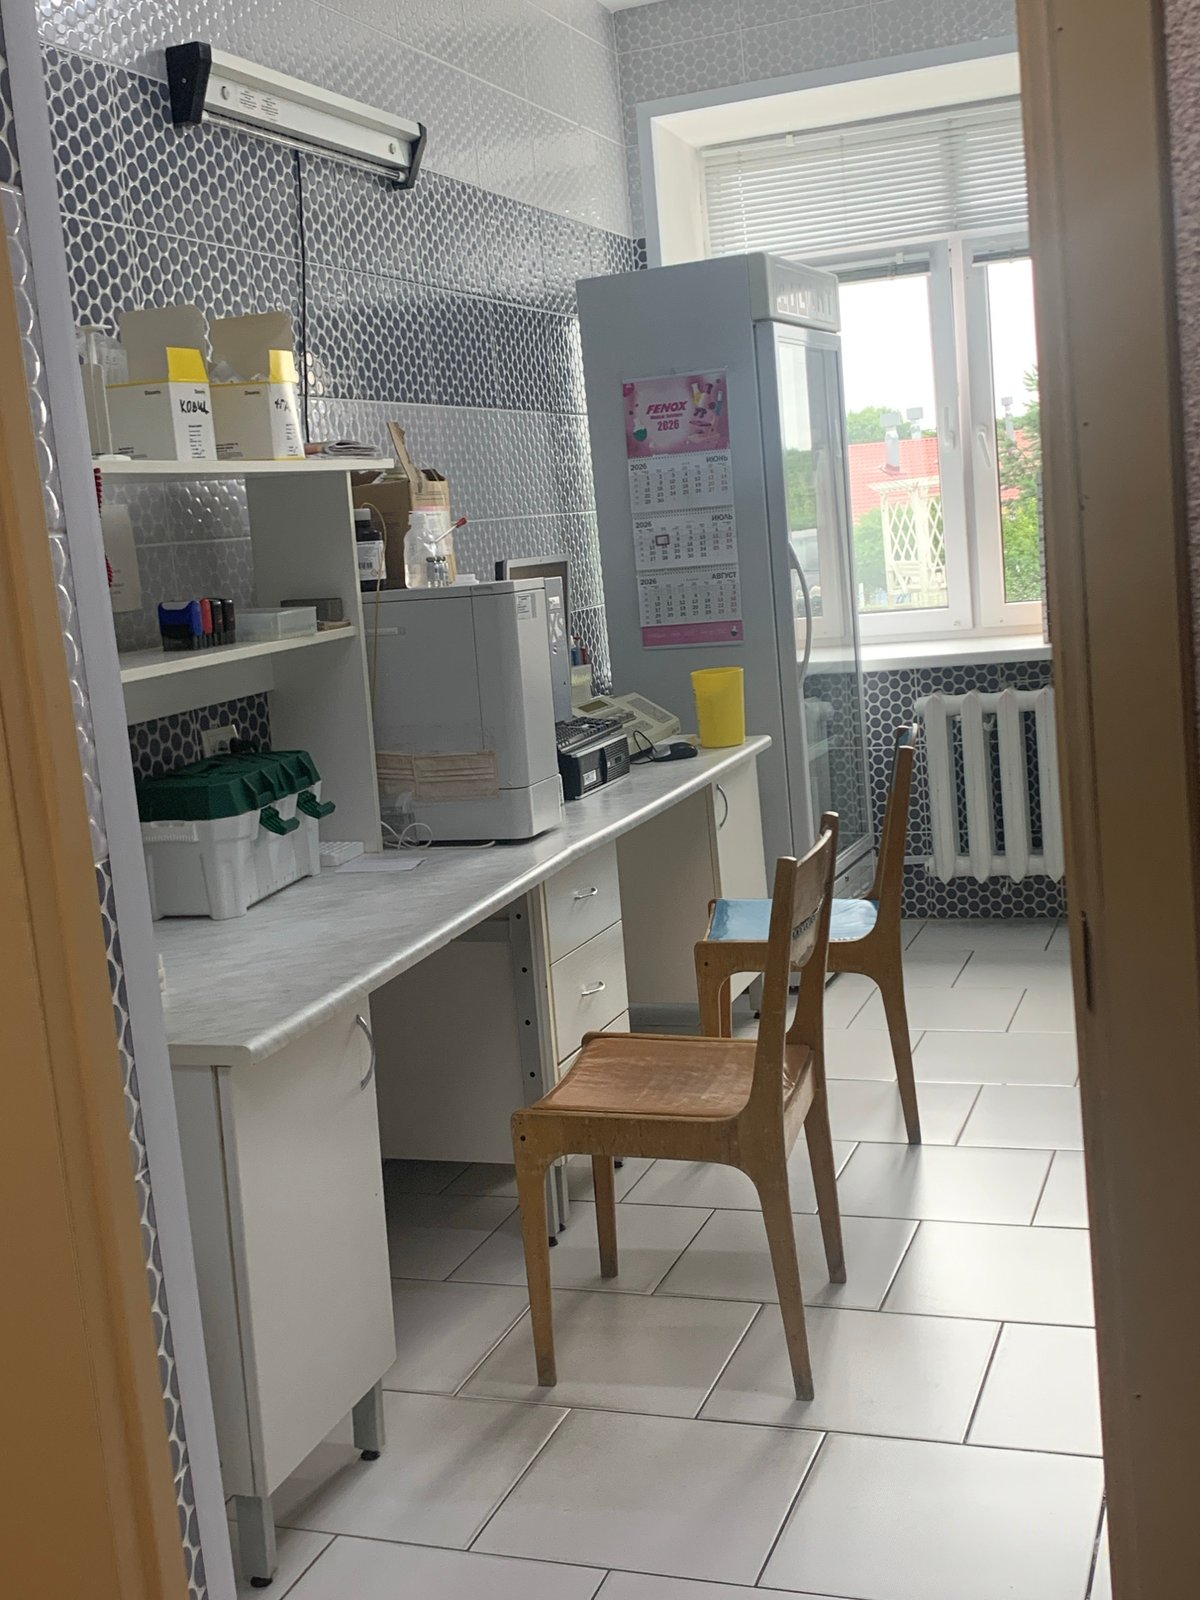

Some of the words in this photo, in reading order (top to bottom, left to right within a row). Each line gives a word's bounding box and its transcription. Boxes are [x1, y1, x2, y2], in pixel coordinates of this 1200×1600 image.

[646, 401, 688, 415] FENOX
[657, 419, 680, 431] 2026
[706, 455, 728, 463] ИЮНЬ
[630, 463, 648, 471] 2026
[711, 513, 733, 521] ИЮЛЬ
[635, 521, 652, 529] 2026
[712, 571, 737, 580] АВГУСТ
